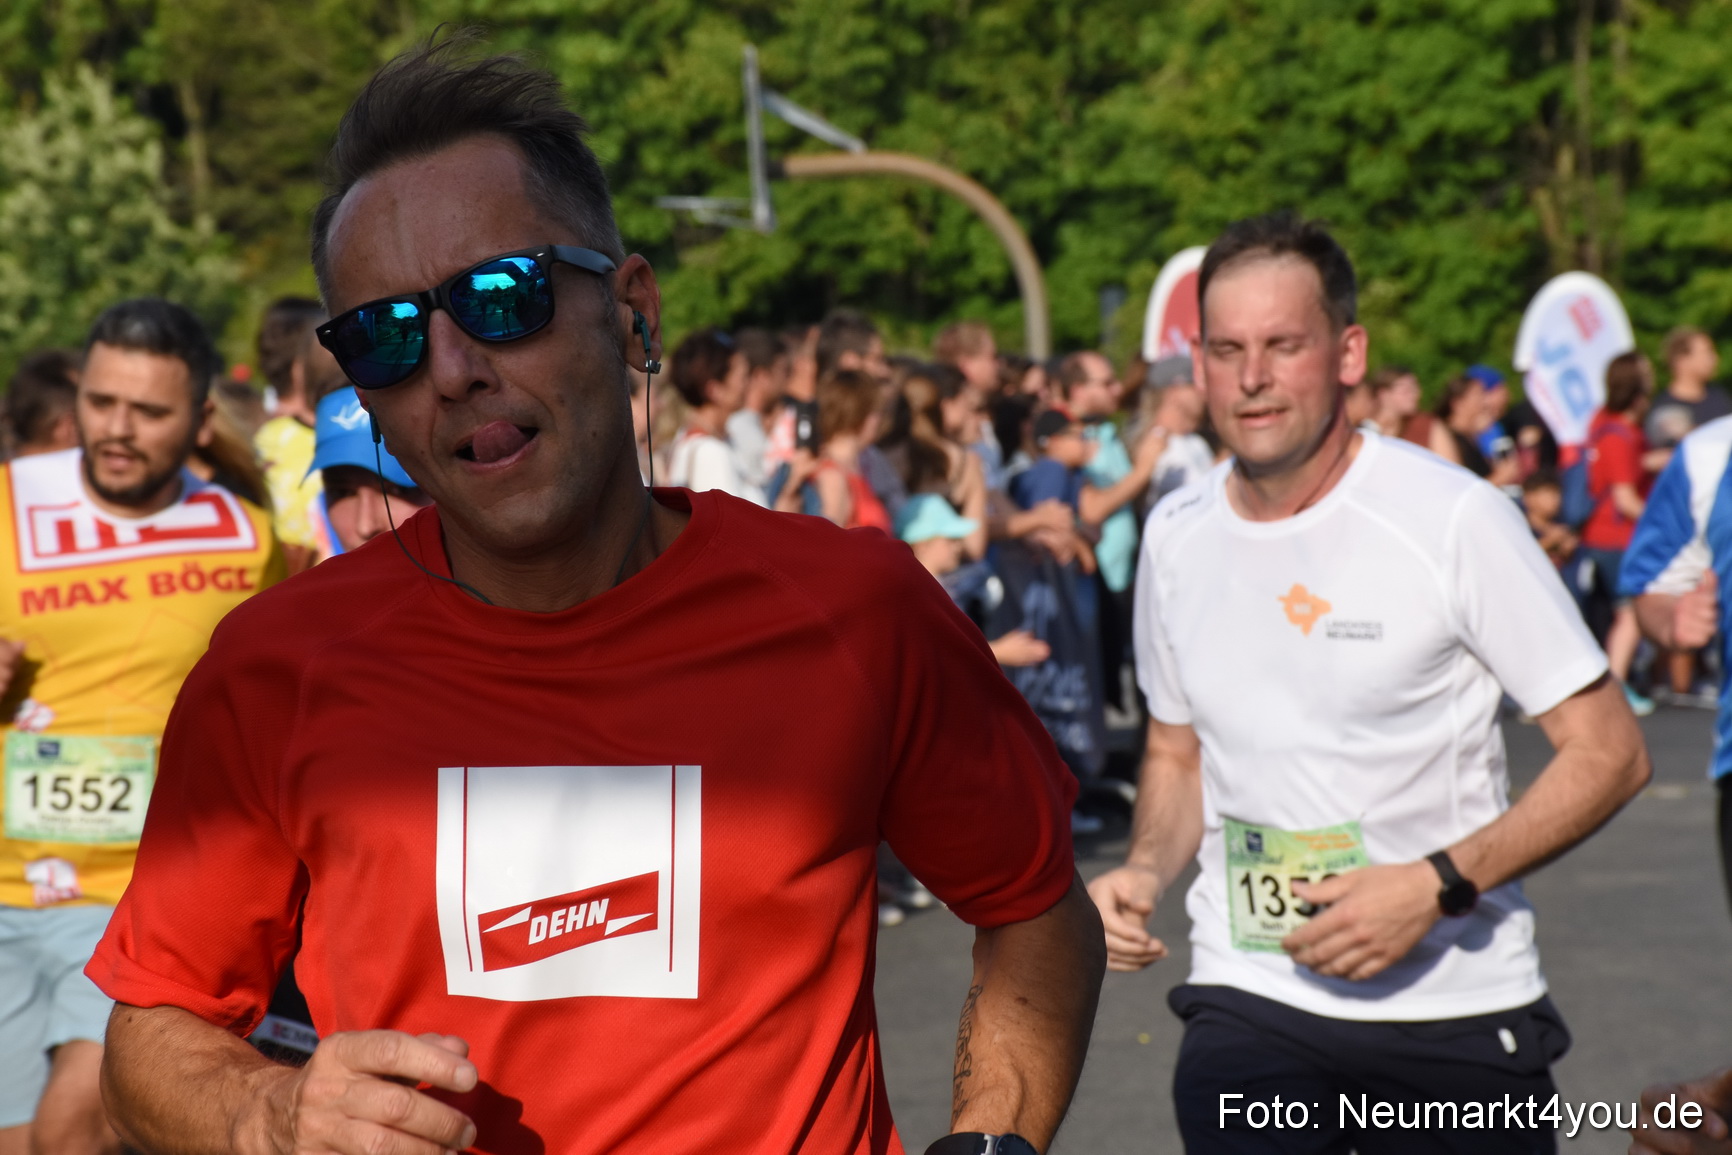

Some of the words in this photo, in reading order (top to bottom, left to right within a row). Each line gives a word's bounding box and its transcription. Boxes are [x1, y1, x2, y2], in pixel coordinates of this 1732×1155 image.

[20, 576, 130, 616] MAX
[148, 561, 256, 598] BÖGL
[23, 772, 132, 812] 1552
[528, 898, 610, 946] DEHN
